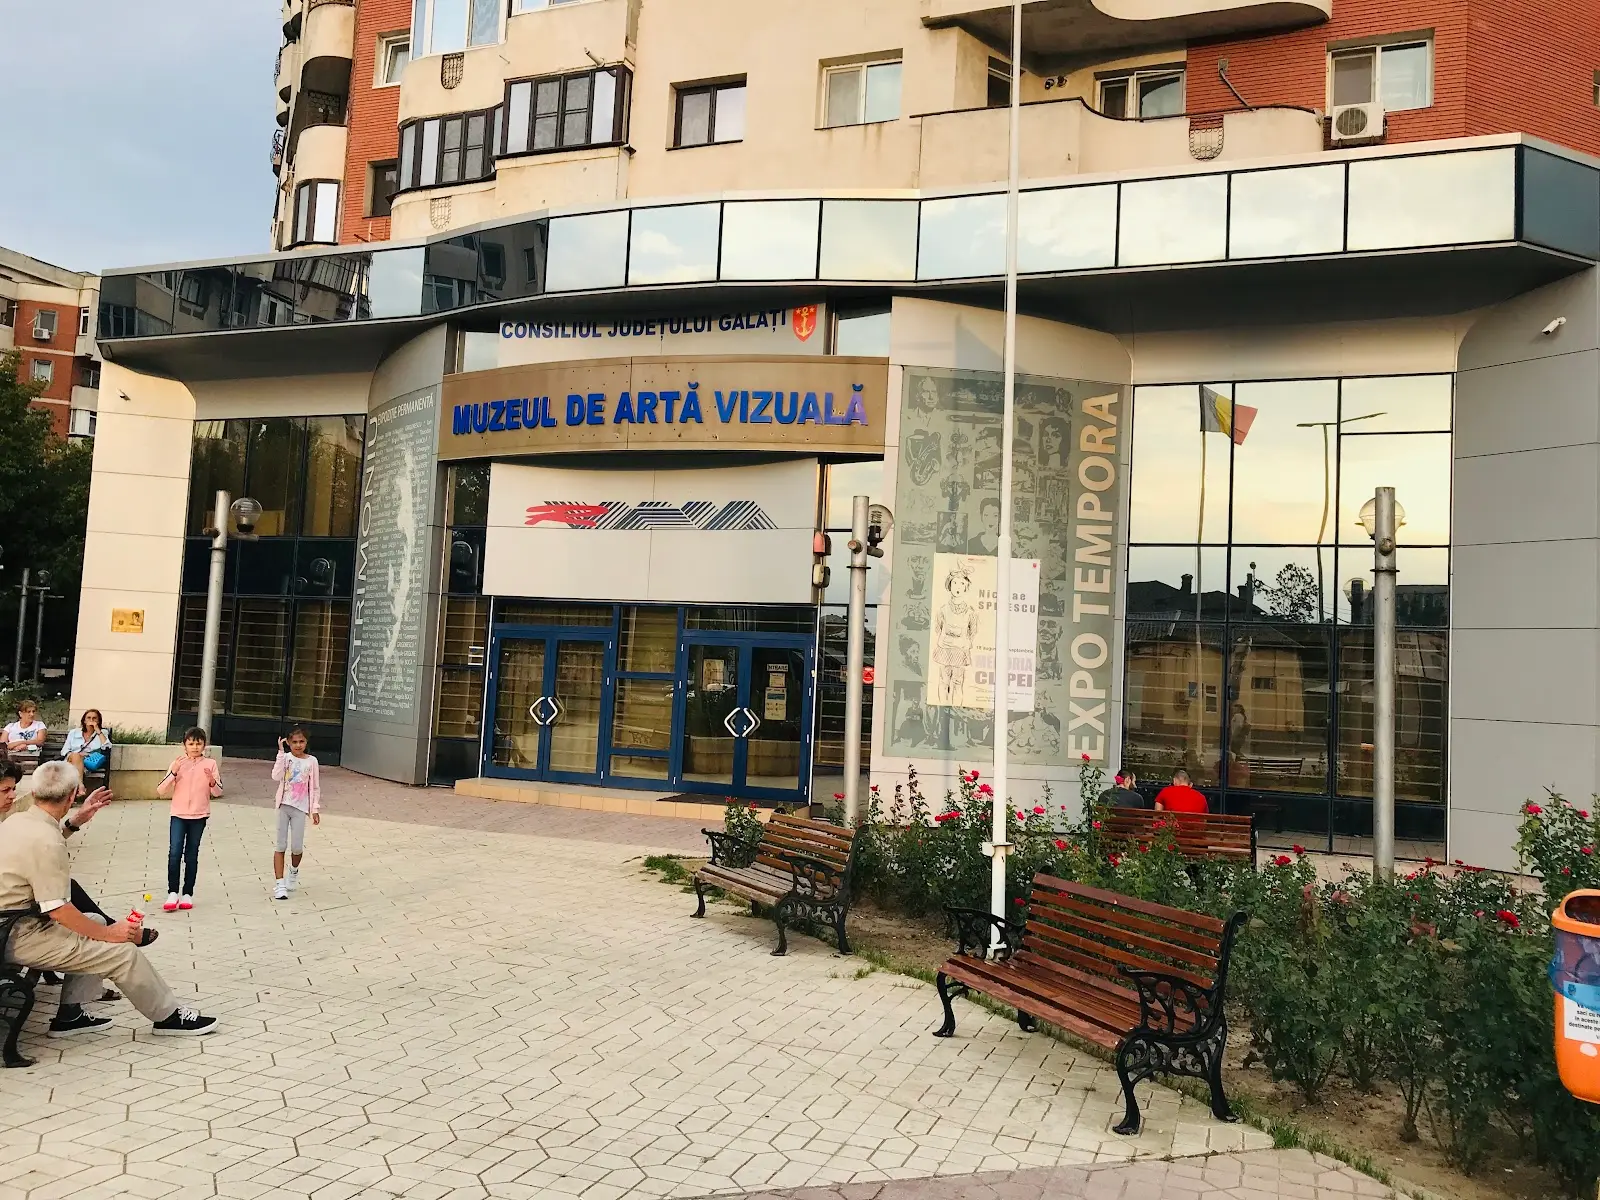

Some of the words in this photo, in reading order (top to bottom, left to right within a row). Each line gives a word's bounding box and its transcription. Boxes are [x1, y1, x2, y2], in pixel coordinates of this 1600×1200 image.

[501, 321, 601, 338] CONSILIUL
[607, 316, 712, 341] JUDEȚULUI
[718, 308, 787, 332] GALAȚI
[452, 397, 557, 435] MUZEUL
[565, 393, 606, 427] DE
[613, 382, 704, 425] ARTĂ
[714, 383, 869, 427] VIZUALĂ
[1073, 392, 1120, 624] TEMPORA
[348, 416, 378, 711] PATRIMONIU
[979, 589, 1026, 601] Nicae
[1068, 640, 1108, 761] EXPO
